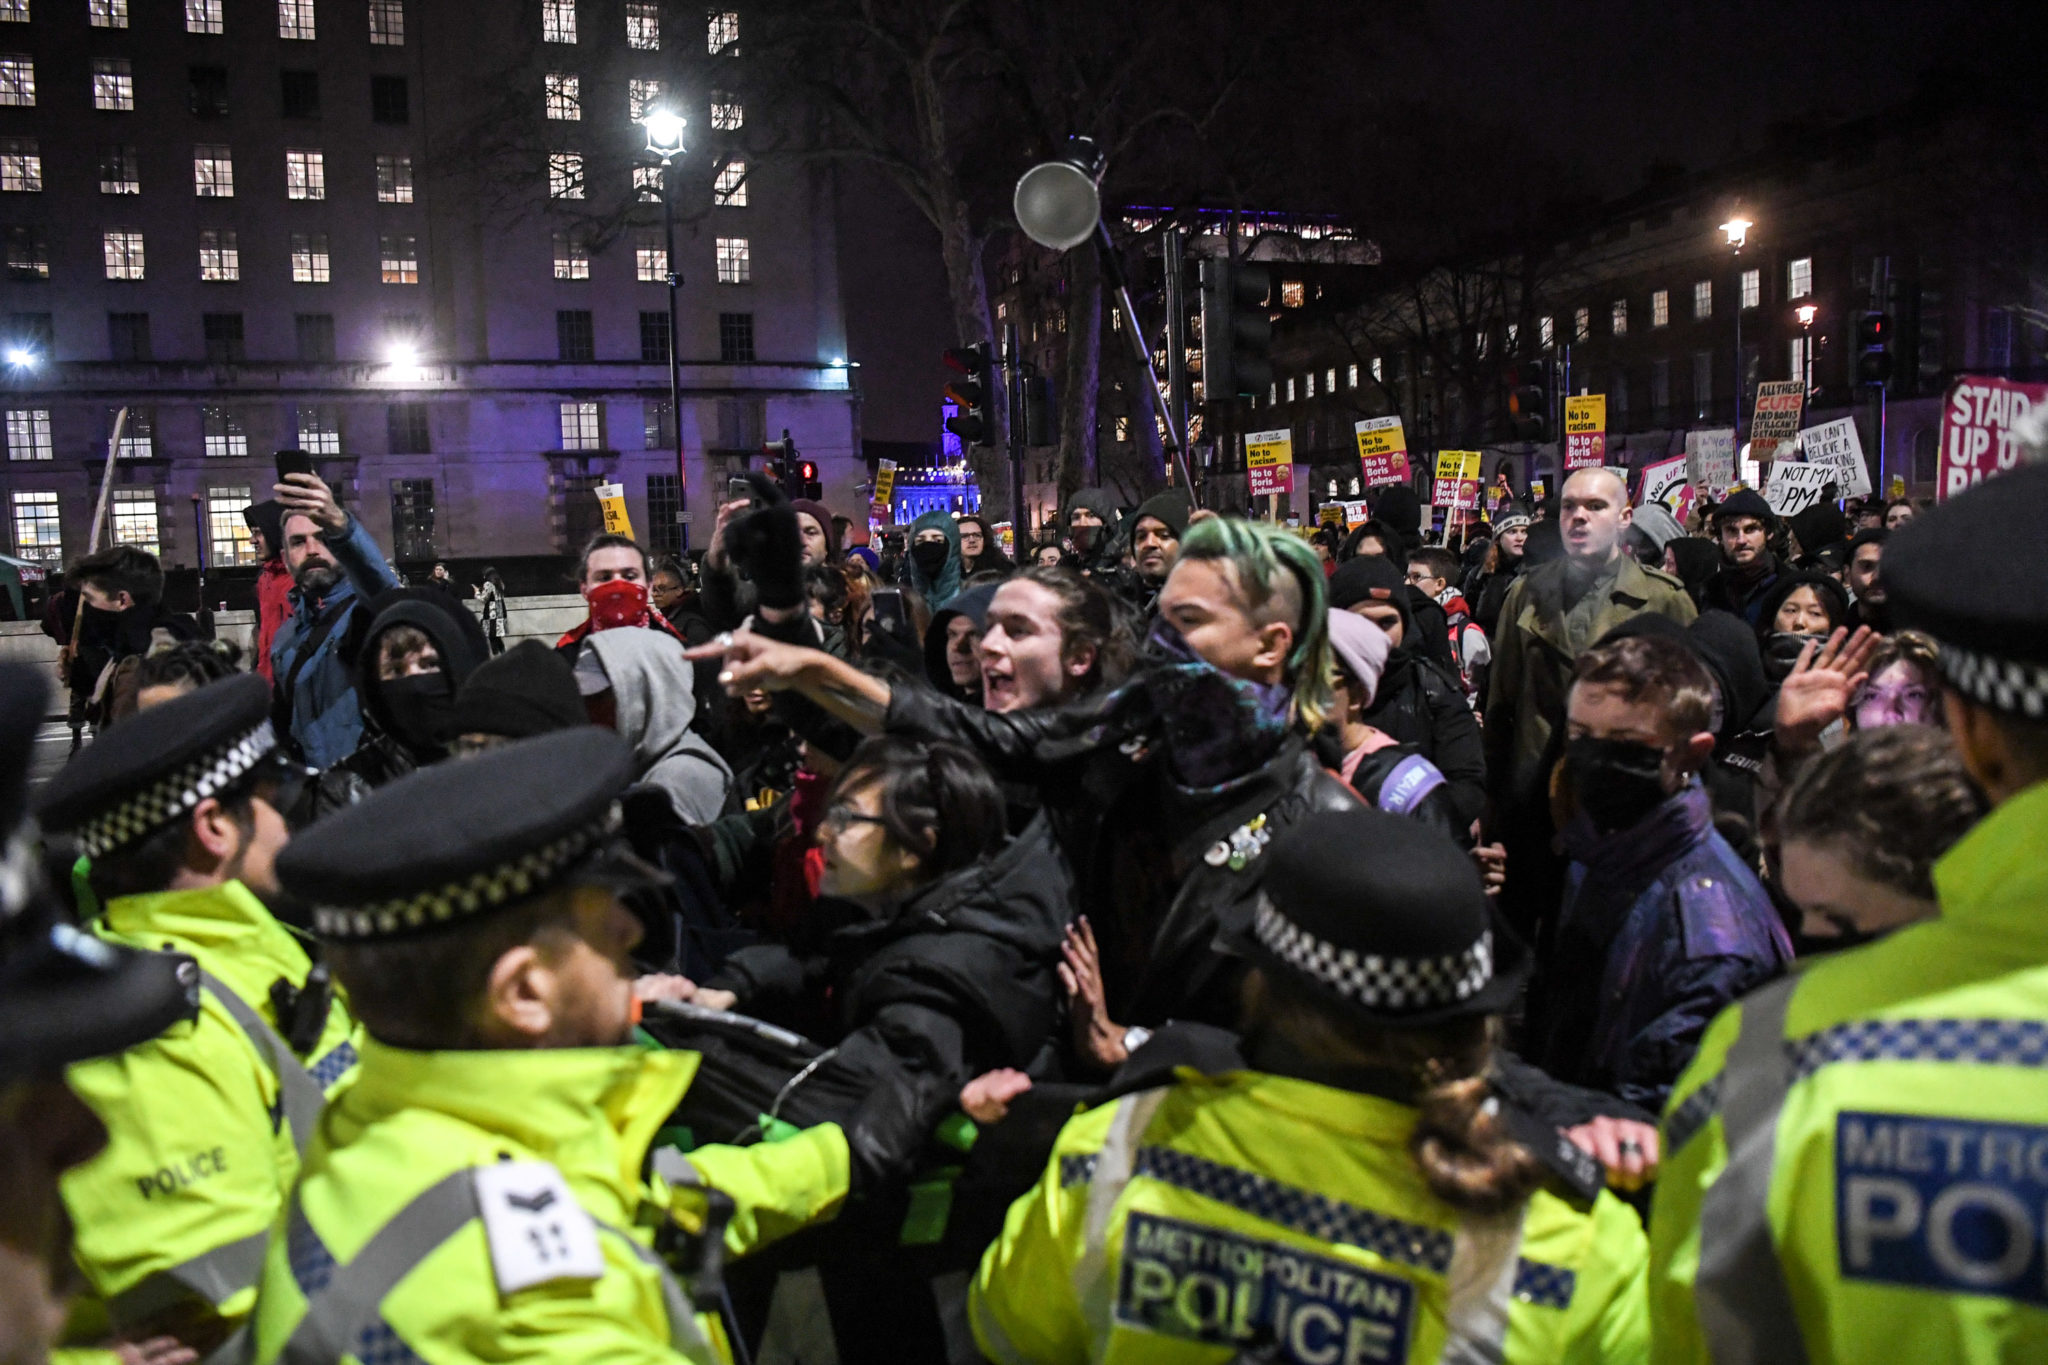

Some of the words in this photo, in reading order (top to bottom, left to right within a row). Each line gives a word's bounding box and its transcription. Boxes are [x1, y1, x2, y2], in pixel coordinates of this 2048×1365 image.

[1760, 385, 1775, 397] ALL
[1776, 382, 1804, 395] THESE
[1757, 394, 1802, 411] CUTS
[1568, 411, 1579, 420] No
[1581, 410, 1590, 420] to
[1755, 411, 1773, 420] AND
[1774, 410, 1798, 420] BORIS
[1569, 421, 1596, 431] racism
[1361, 438, 1373, 446] No
[1374, 436, 1383, 444] to
[1568, 436, 1580, 447] No
[1581, 436, 1590, 446] to
[1806, 431, 1822, 445] YOU
[1363, 445, 1390, 455] racism
[1569, 446, 1590, 456] Boris
[1808, 440, 1840, 460] BELIEVE
[1844, 438, 1851, 451] A
[1950, 426, 1990, 466] UP
[1250, 457, 1277, 465] racism
[1364, 458, 1377, 467] No
[1378, 457, 1387, 465] to
[1440, 461, 1451, 469] No
[1568, 457, 1602, 468] Johnson
[1251, 469, 1262, 478] No
[1264, 469, 1272, 477] to
[1366, 466, 1388, 476] Boris
[1780, 466, 1810, 481] NOT
[1809, 467, 1835, 484] MY
[1252, 478, 1273, 487] Boris
[1369, 474, 1402, 486] Johnson
[1437, 480, 1449, 489] No
[1253, 486, 1285, 496] Johnson
[1779, 486, 1818, 512] PM
[136, 1146, 226, 1201] POLICE
[1845, 1173, 2048, 1285] PO
